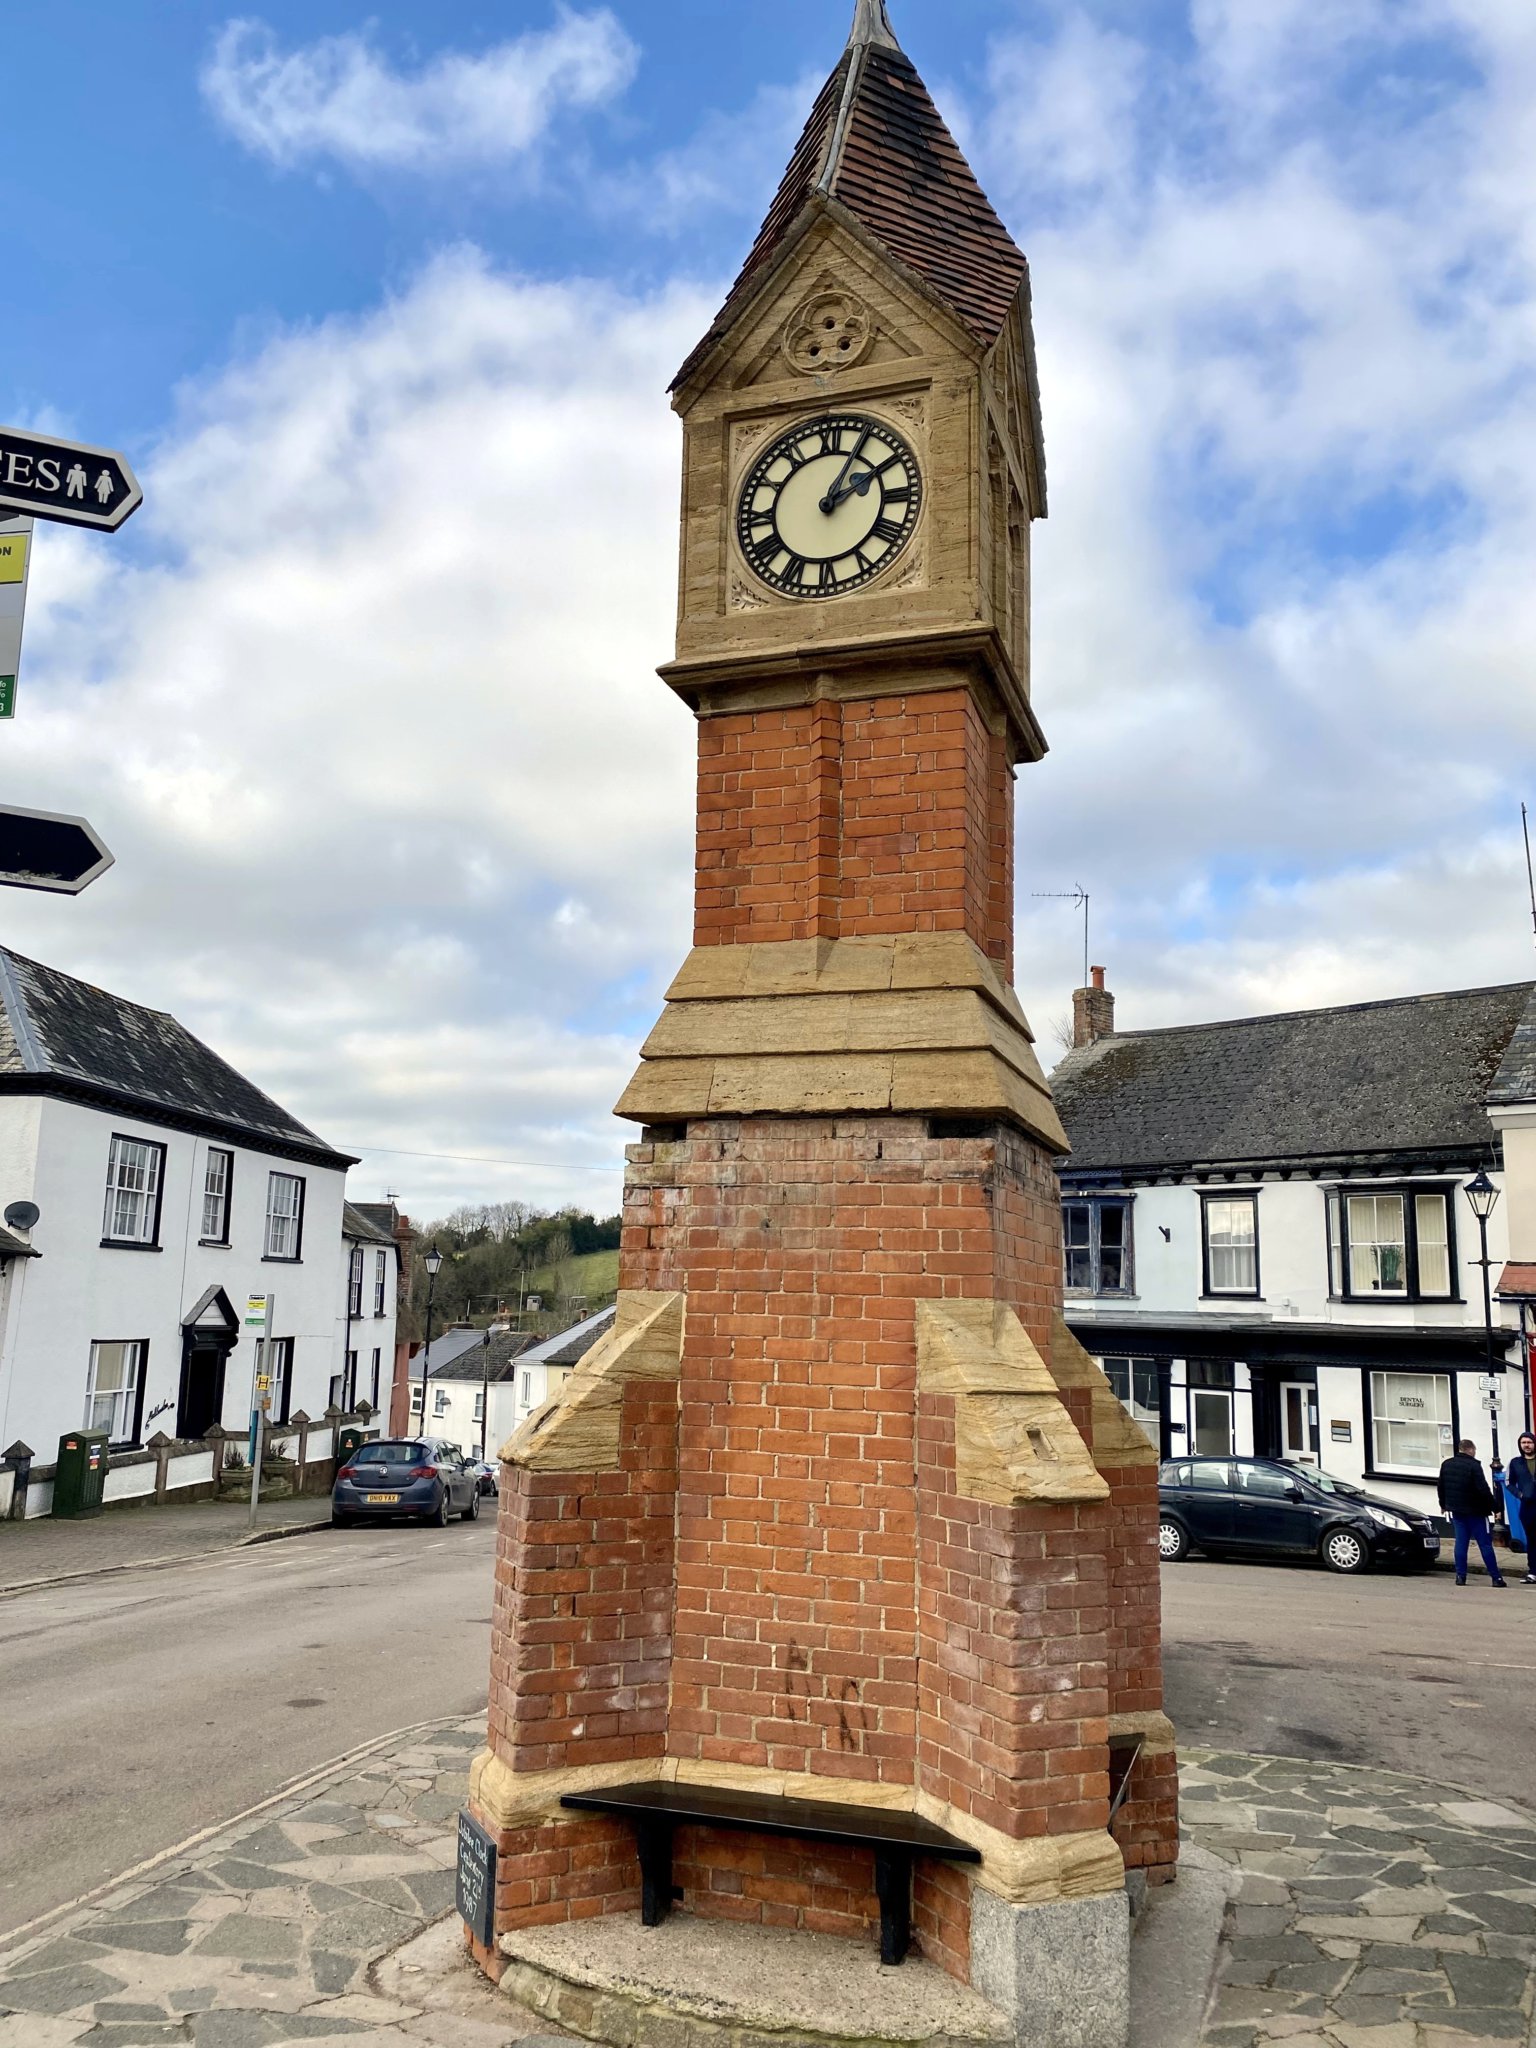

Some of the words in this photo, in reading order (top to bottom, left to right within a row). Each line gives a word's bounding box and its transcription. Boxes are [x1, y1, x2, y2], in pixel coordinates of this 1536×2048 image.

[780, 442, 806, 468] XI
[0, 450, 60, 491] ES
[0, 546, 11, 556] N
[853, 549, 877, 573] V
[459, 1819, 474, 1850] Jubilee
[475, 1838, 488, 1866] Clock
